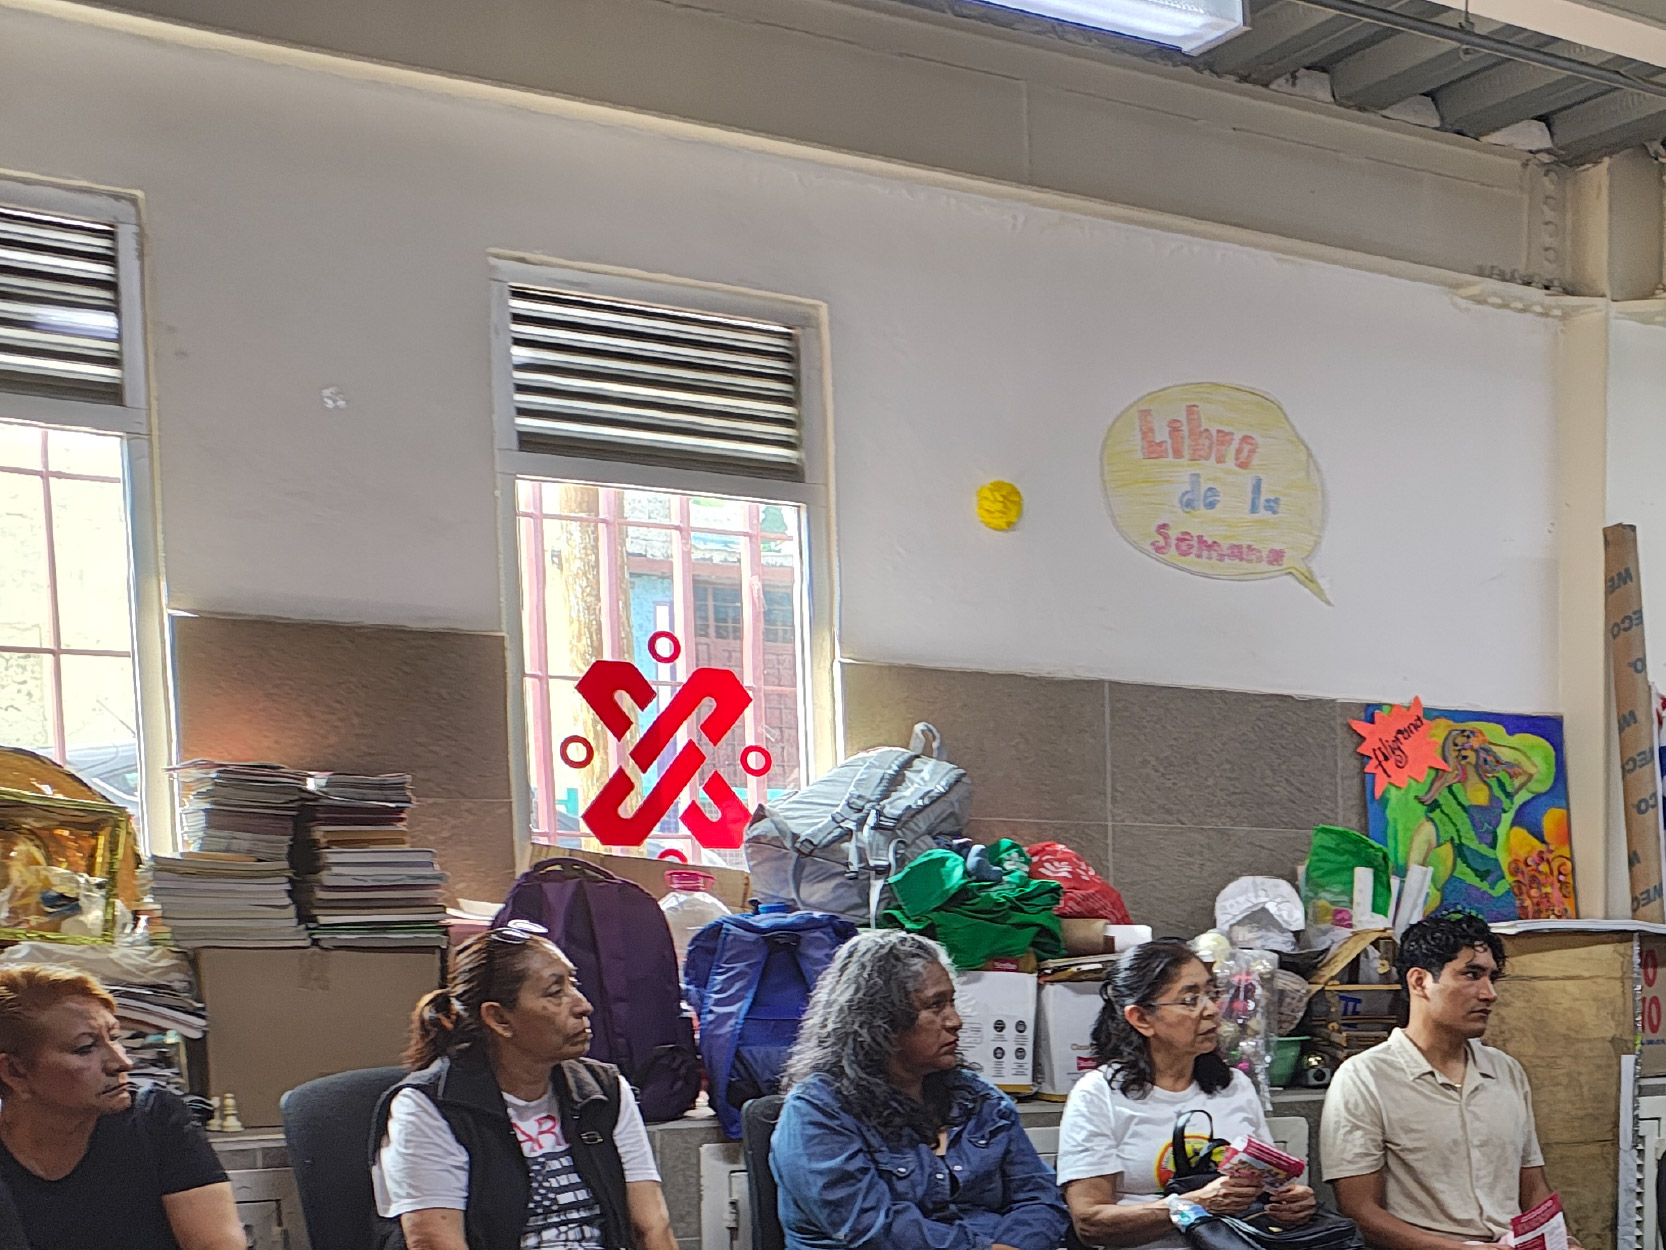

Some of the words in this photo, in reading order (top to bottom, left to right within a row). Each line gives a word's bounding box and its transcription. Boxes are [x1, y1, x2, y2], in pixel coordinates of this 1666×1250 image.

[1138, 404, 1258, 470] Libro
[1179, 473, 1220, 513] de
[1250, 475, 1281, 515] la
[1151, 522, 1286, 567] Semana
